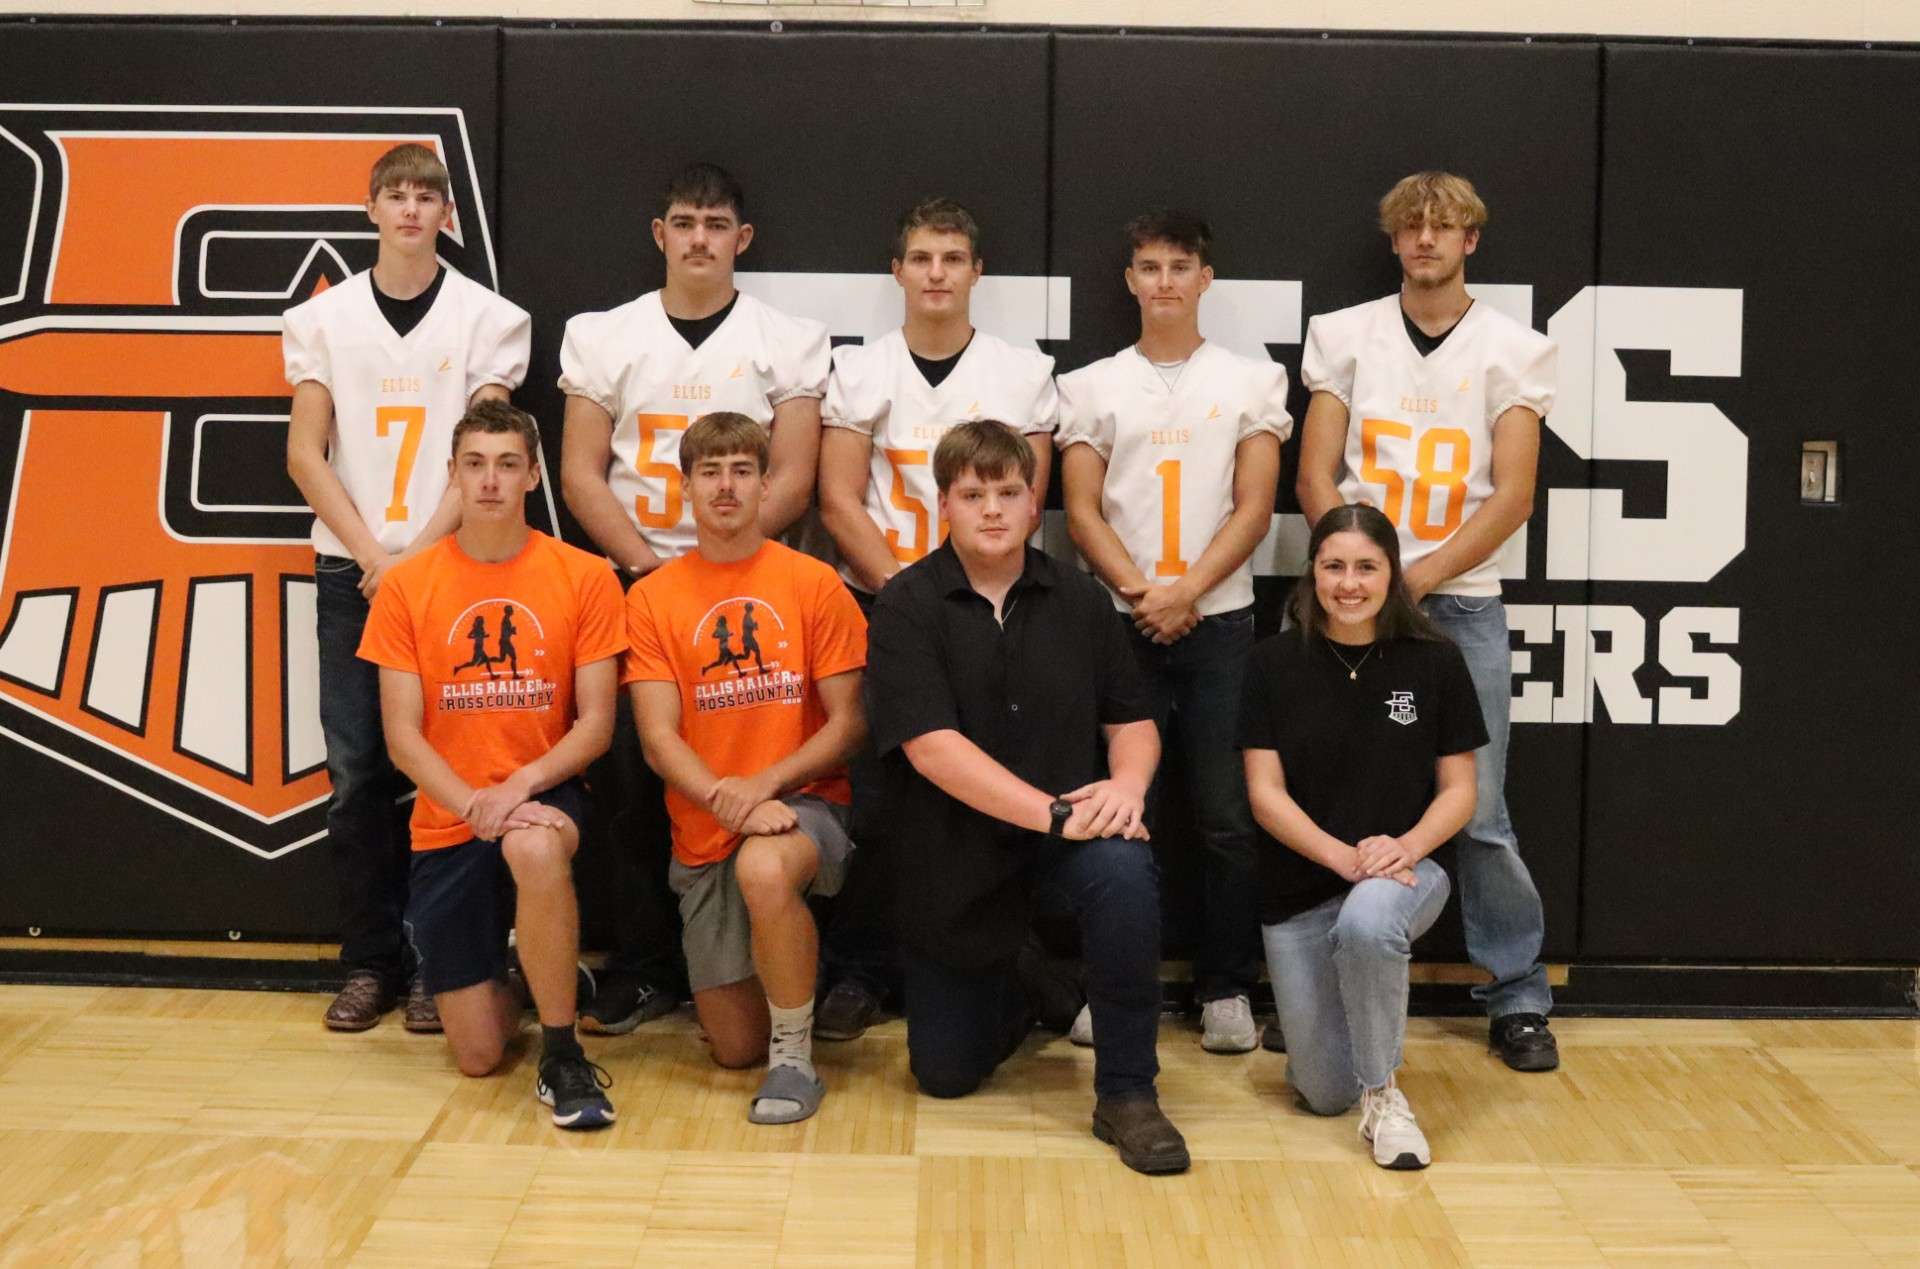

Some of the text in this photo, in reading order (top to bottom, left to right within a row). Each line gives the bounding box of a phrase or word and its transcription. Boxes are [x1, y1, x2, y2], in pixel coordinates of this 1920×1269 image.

[380, 378, 420, 392] ELLIS
[672, 385, 711, 399] ELLIS
[1401, 398, 1438, 413] ELLIS
[376, 406, 426, 522] 7
[1151, 430, 1190, 444] ELLIS
[635, 414, 700, 529] 5
[1360, 418, 1471, 541] 58
[884, 448, 949, 562] 5
[1155, 459, 1187, 577] 1
[443, 682, 483, 698] ELLIS
